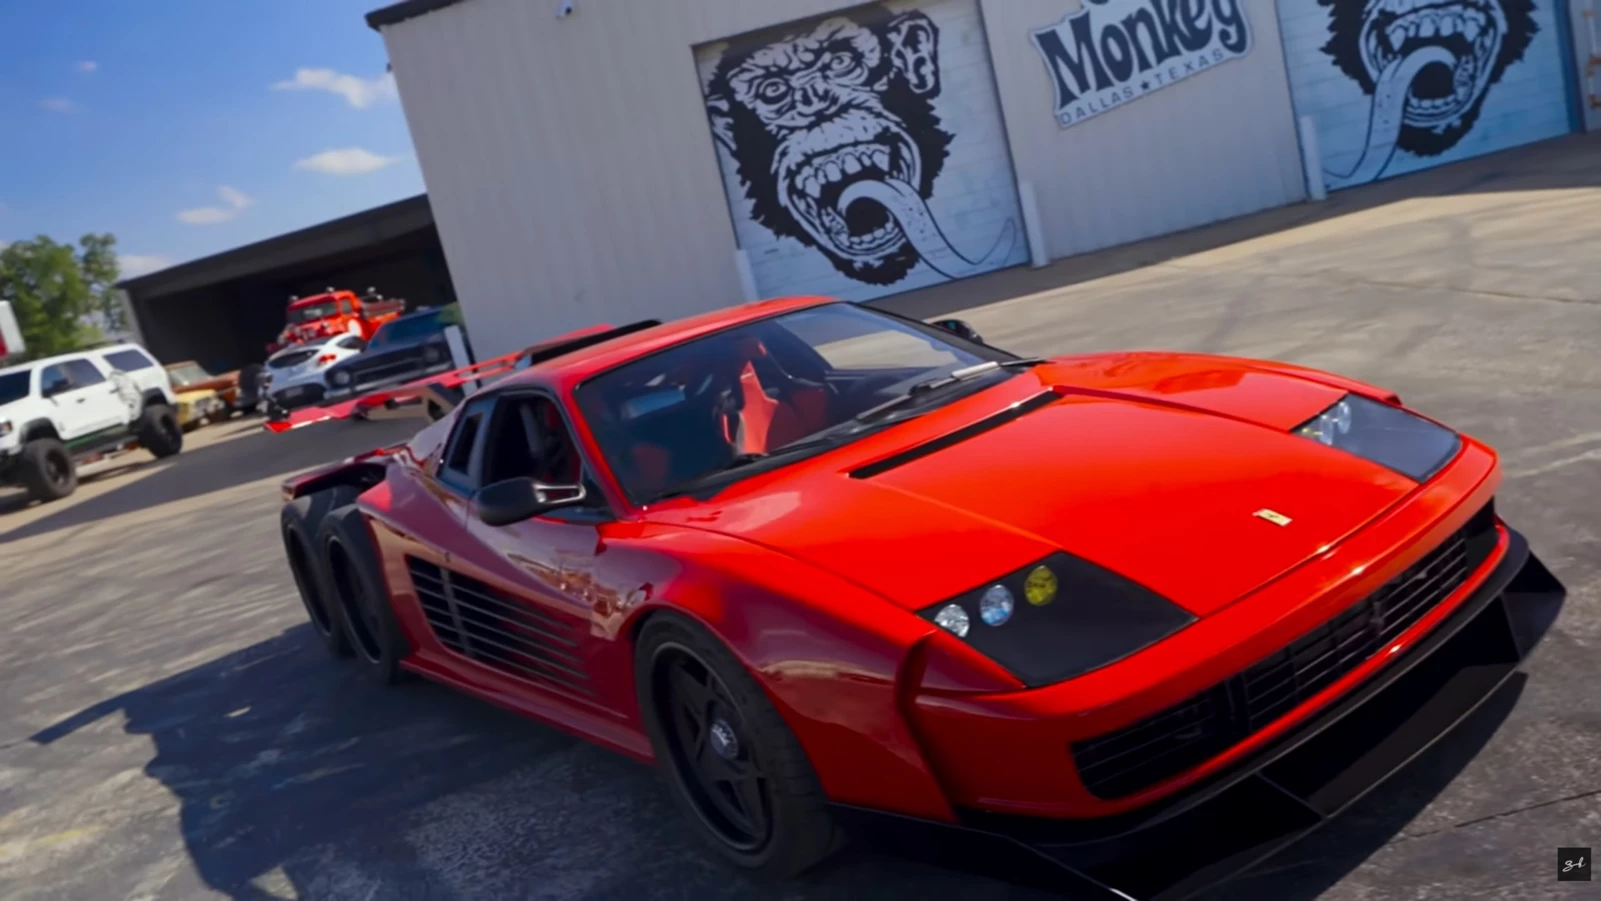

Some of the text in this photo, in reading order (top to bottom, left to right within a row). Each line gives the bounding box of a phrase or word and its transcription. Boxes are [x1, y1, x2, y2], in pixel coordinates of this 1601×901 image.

[1035, 0, 1247, 110] Monkey
[1060, 48, 1224, 125] DALLAS TEXAS
